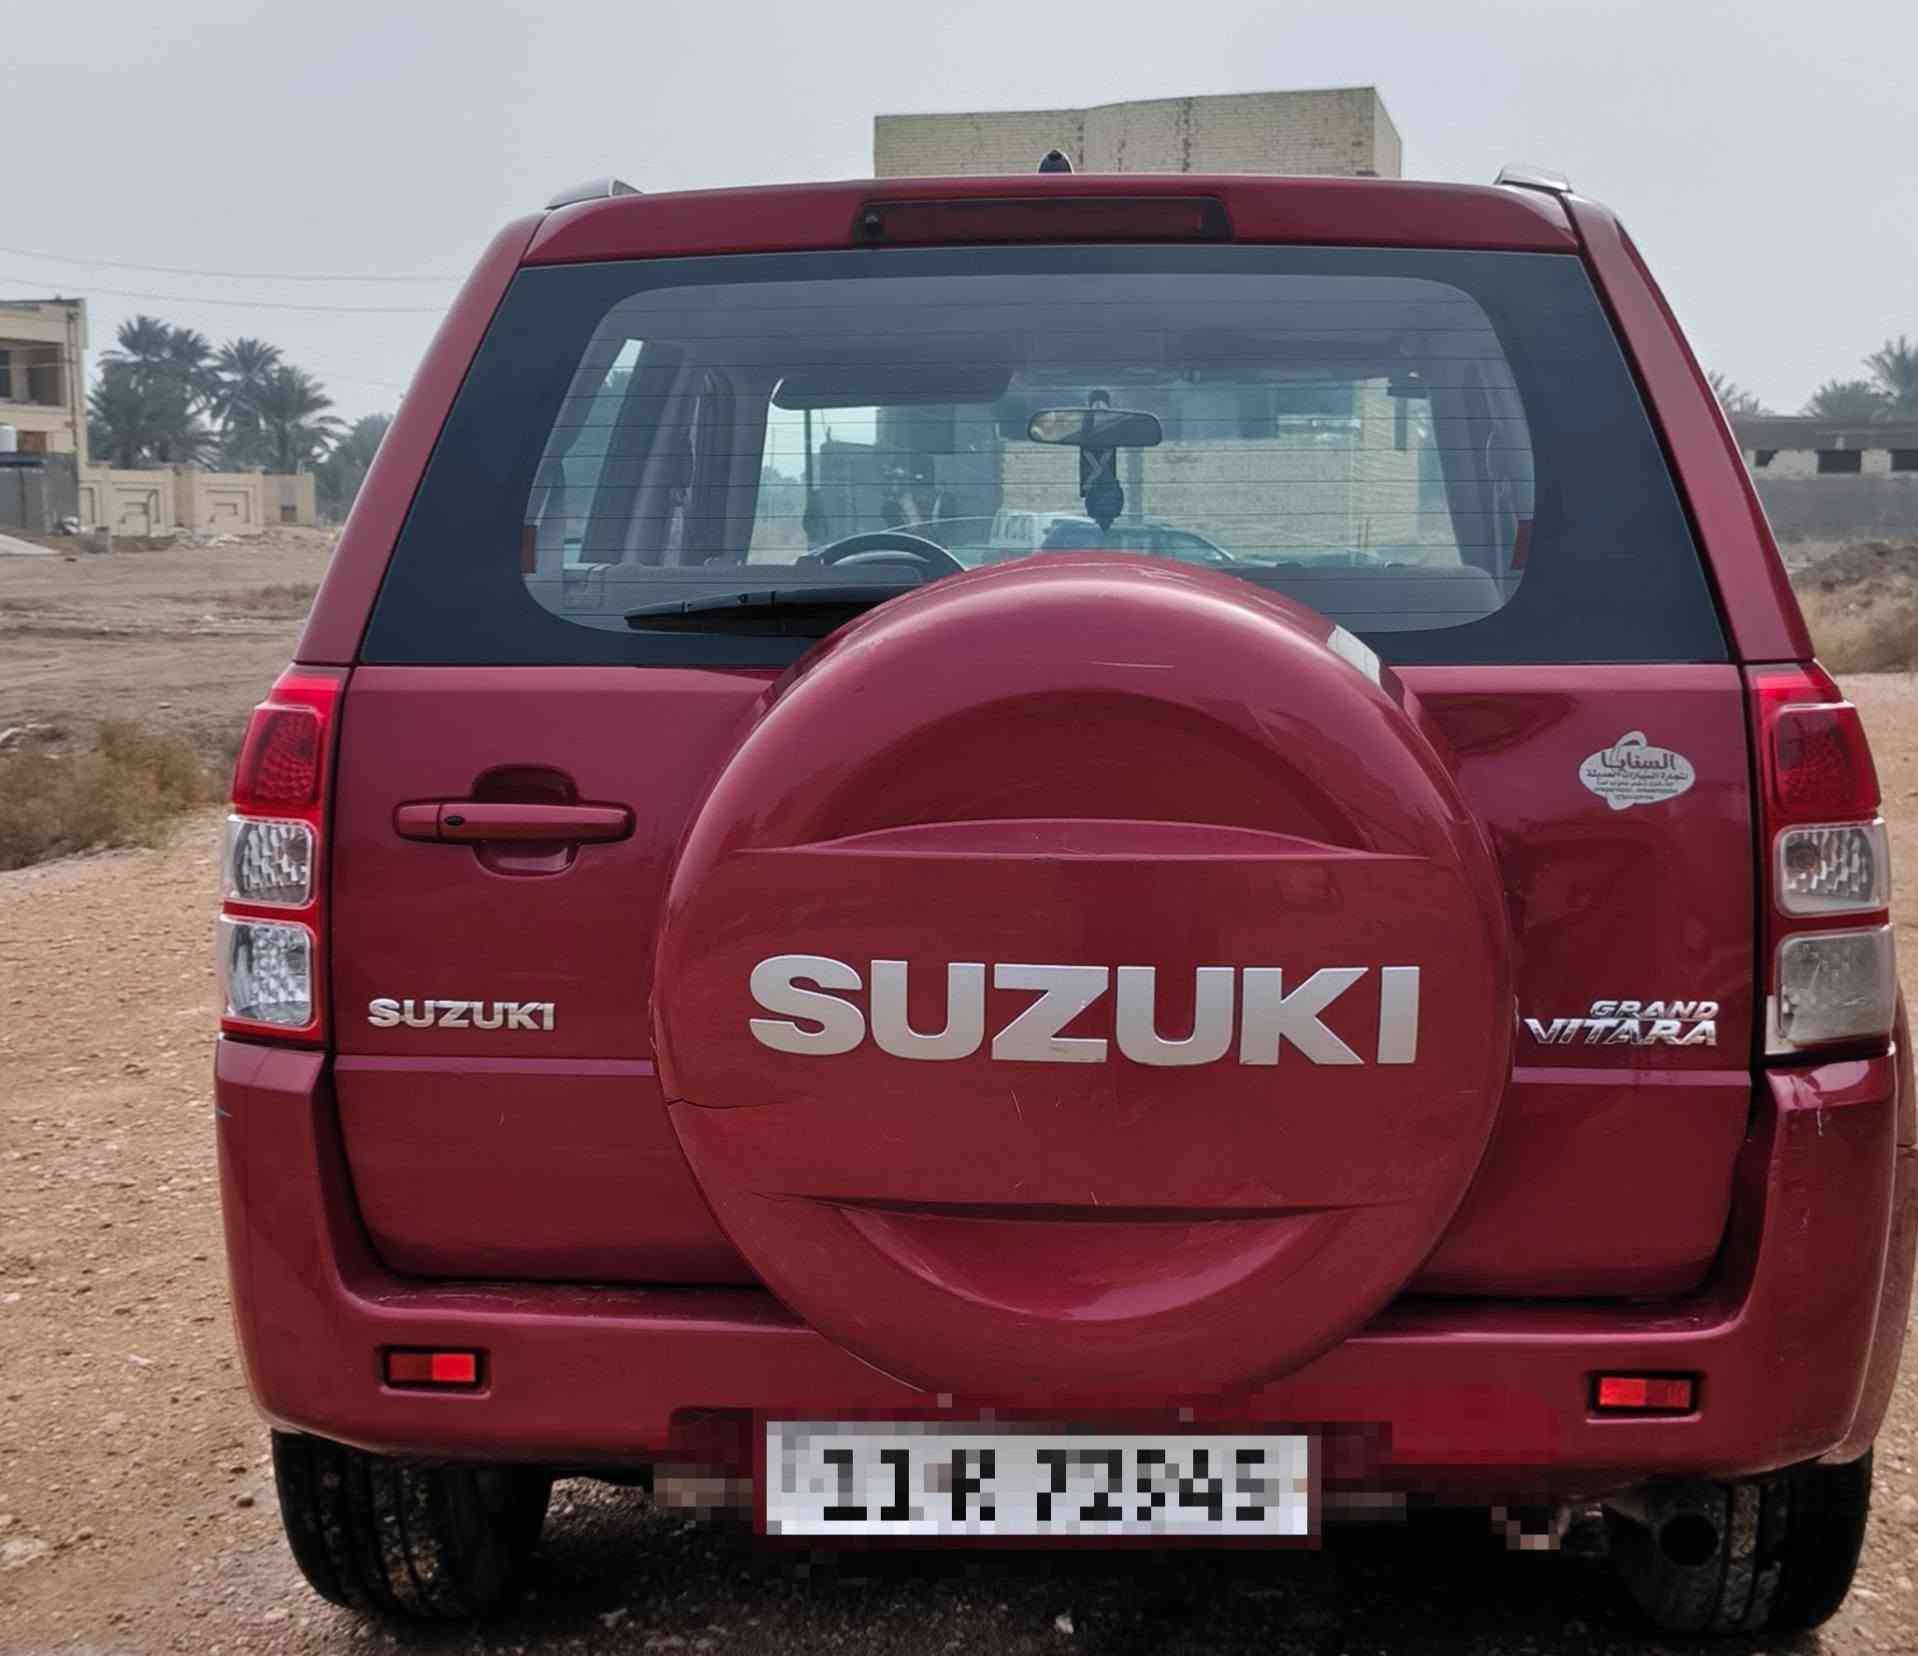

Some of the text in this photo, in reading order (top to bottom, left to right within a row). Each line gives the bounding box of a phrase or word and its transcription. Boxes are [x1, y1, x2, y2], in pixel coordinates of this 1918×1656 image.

[368, 998, 555, 1030] SUZUKI
[749, 954, 1420, 1066] SUZUKI
[1590, 1000, 1719, 1019] GRAND
[1524, 1017, 1718, 1046] VITARA
